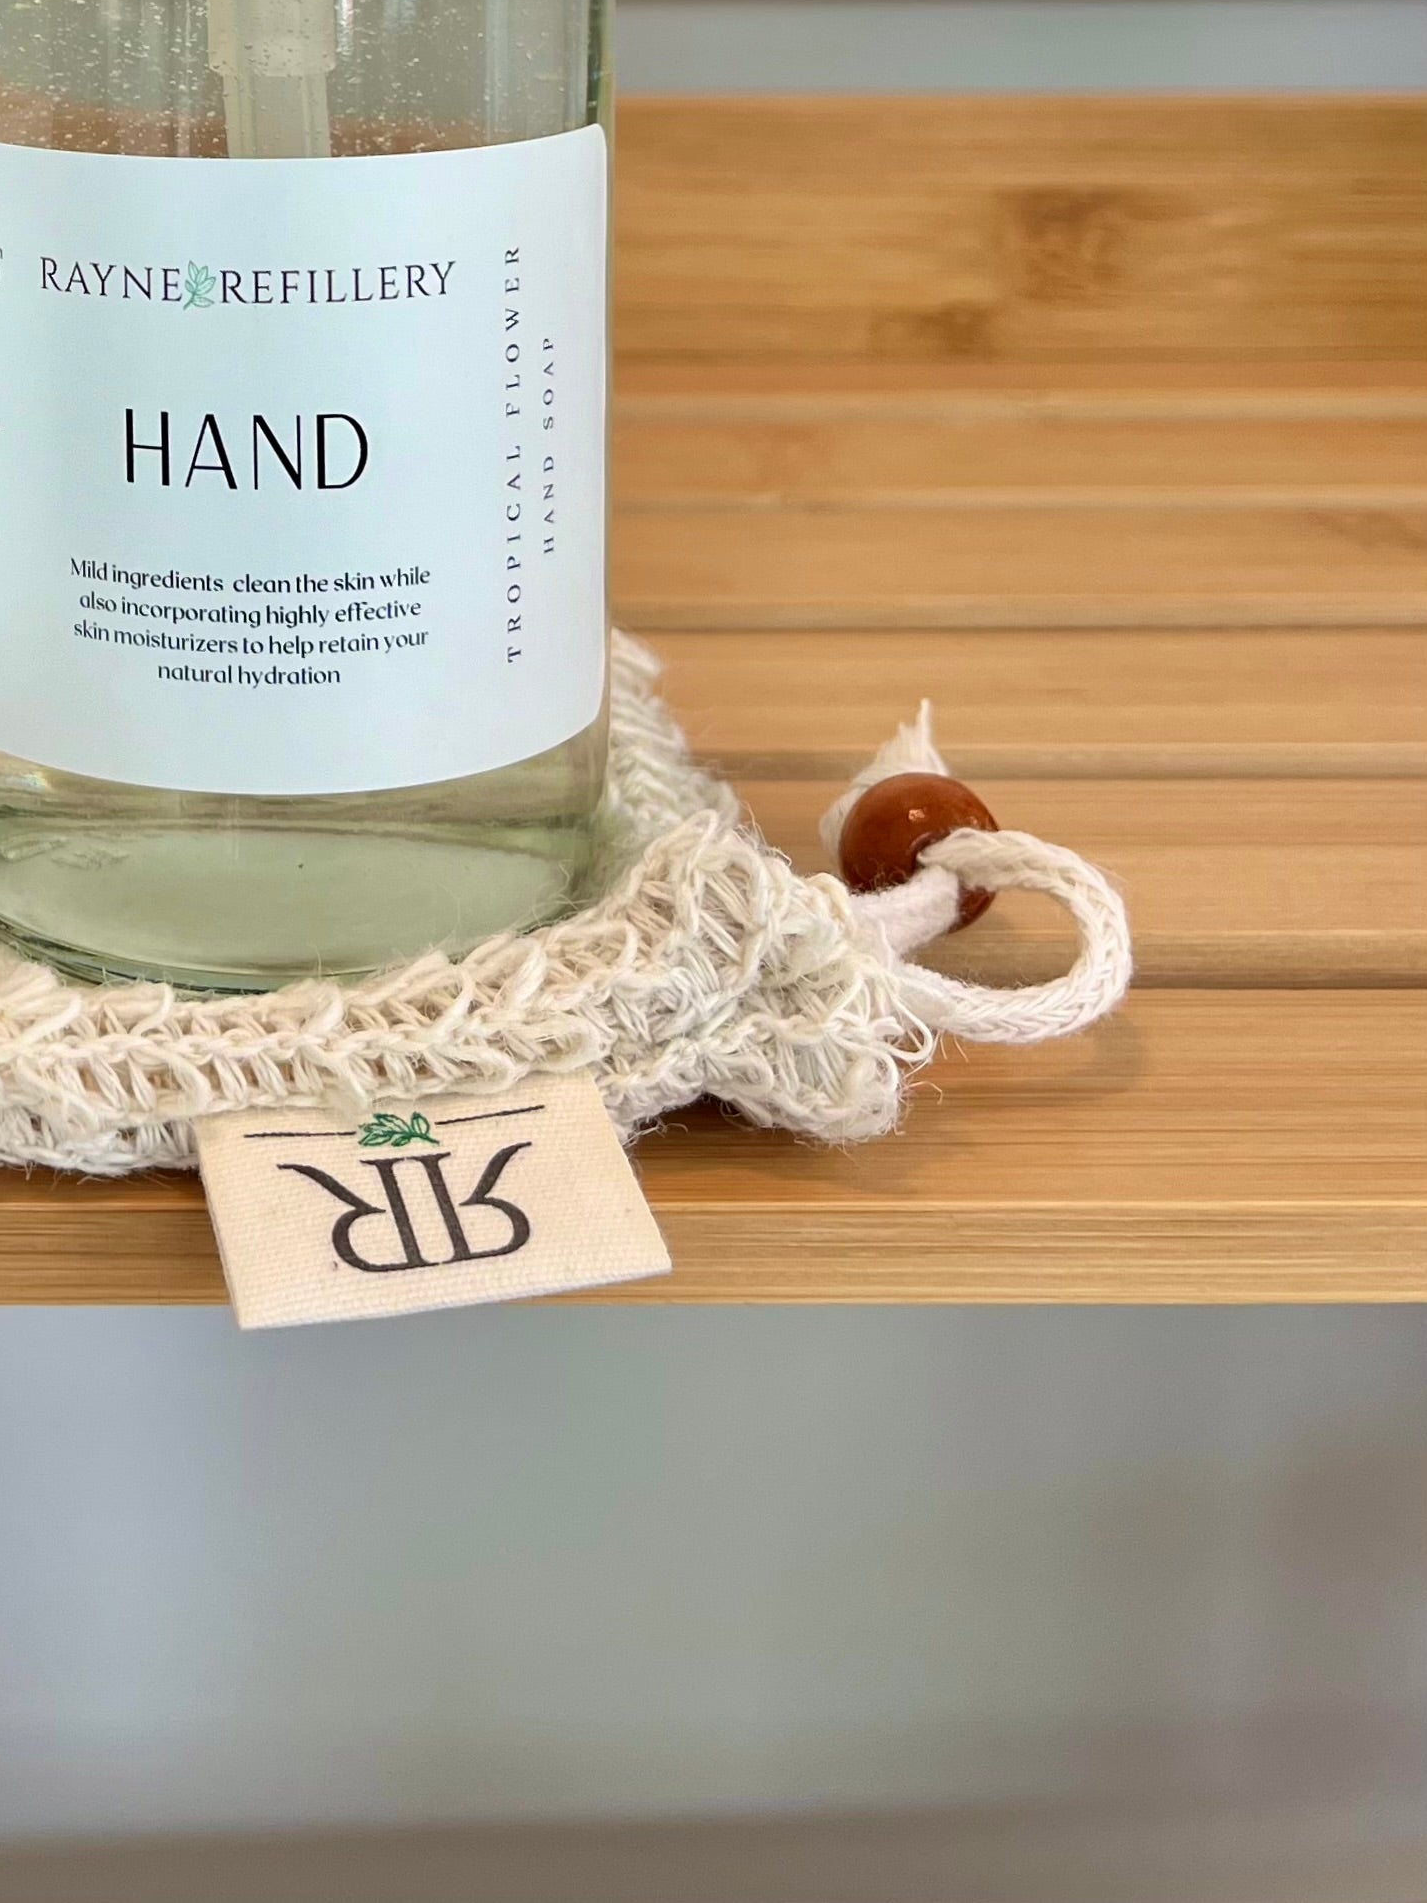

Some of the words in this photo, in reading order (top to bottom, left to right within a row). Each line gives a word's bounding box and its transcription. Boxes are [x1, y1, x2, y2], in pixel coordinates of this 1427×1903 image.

[39, 255, 183, 303] RAYNE
[218, 260, 457, 305] REFILLERY
[504, 246, 521, 419] FLOWER
[542, 337, 555, 431] SOAP
[124, 407, 369, 491] HAND
[542, 455, 555, 555] HAND
[70, 556, 109, 582] Mild
[111, 563, 225, 593] ingredients
[232, 572, 292, 595] clean
[295, 572, 329, 594] the
[332, 571, 376, 593] skin
[379, 565, 431, 589] while
[505, 445, 522, 664] TROPICAL
[73, 618, 110, 643] skin
[113, 628, 239, 655] moisturizers
[242, 636, 265, 655] to
[268, 634, 315, 660] help
[318, 632, 380, 655] retain
[383, 630, 430, 655] your
[78, 589, 118, 614] also
[121, 595, 262, 630] incorporating
[265, 603, 331, 630] highly
[334, 599, 422, 623] effective
[157, 663, 234, 685] natural
[237, 663, 341, 690] hydration
